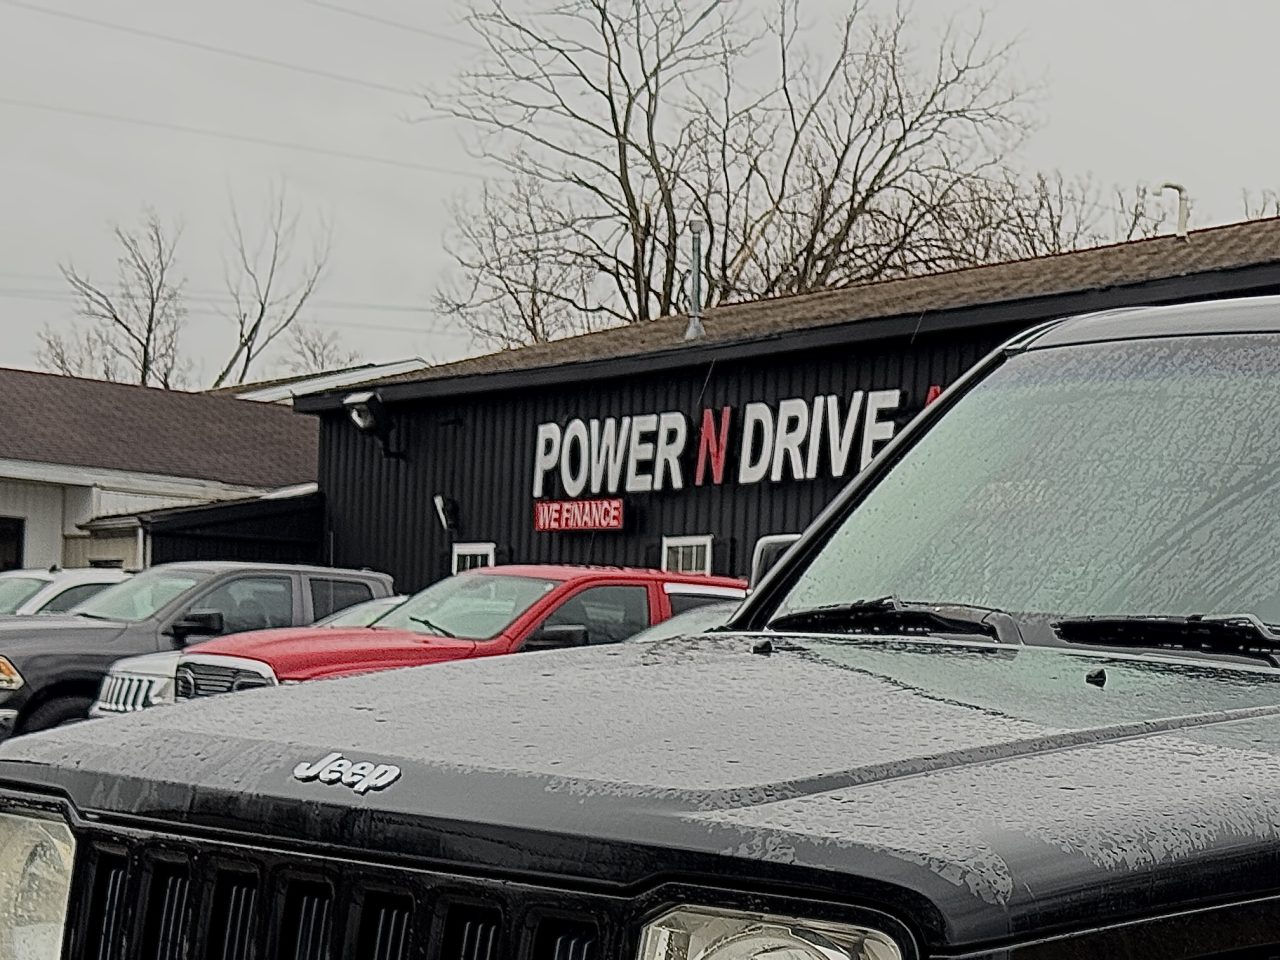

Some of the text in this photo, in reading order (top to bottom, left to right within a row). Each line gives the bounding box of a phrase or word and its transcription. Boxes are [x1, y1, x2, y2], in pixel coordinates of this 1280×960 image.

[533, 389, 900, 498] POWER N DRIVE
[538, 500, 620, 529] WE FINANCE
[293, 752, 402, 796] Jeep
